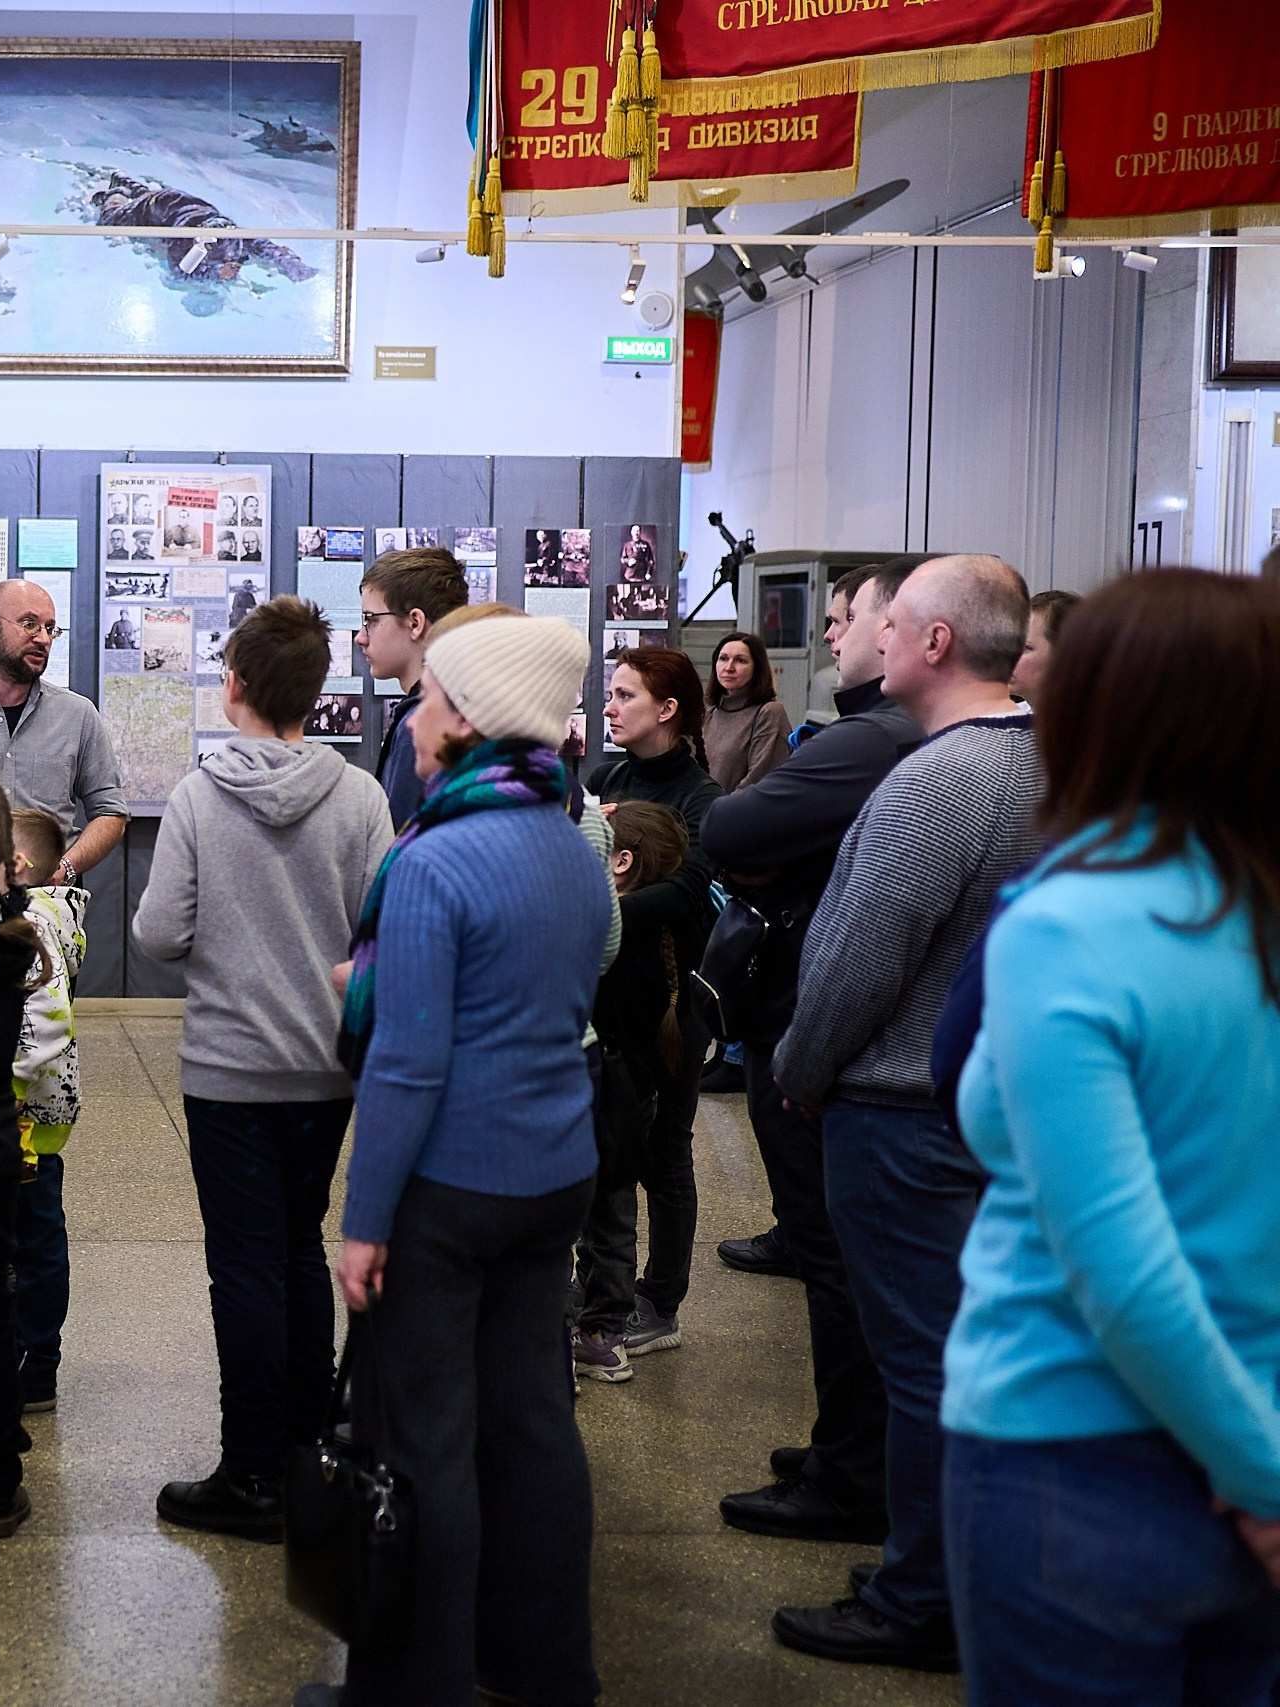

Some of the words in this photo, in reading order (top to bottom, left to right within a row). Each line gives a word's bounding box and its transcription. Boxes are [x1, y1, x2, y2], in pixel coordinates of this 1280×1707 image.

[520, 66, 599, 128] 29
[687, 114, 819, 150] ДИВИЗИЯ
[1152, 112, 1168, 142] 9
[1115, 141, 1259, 178] СТРЕЛКОВАЯ
[612, 340, 666, 359] ВЫХОД
